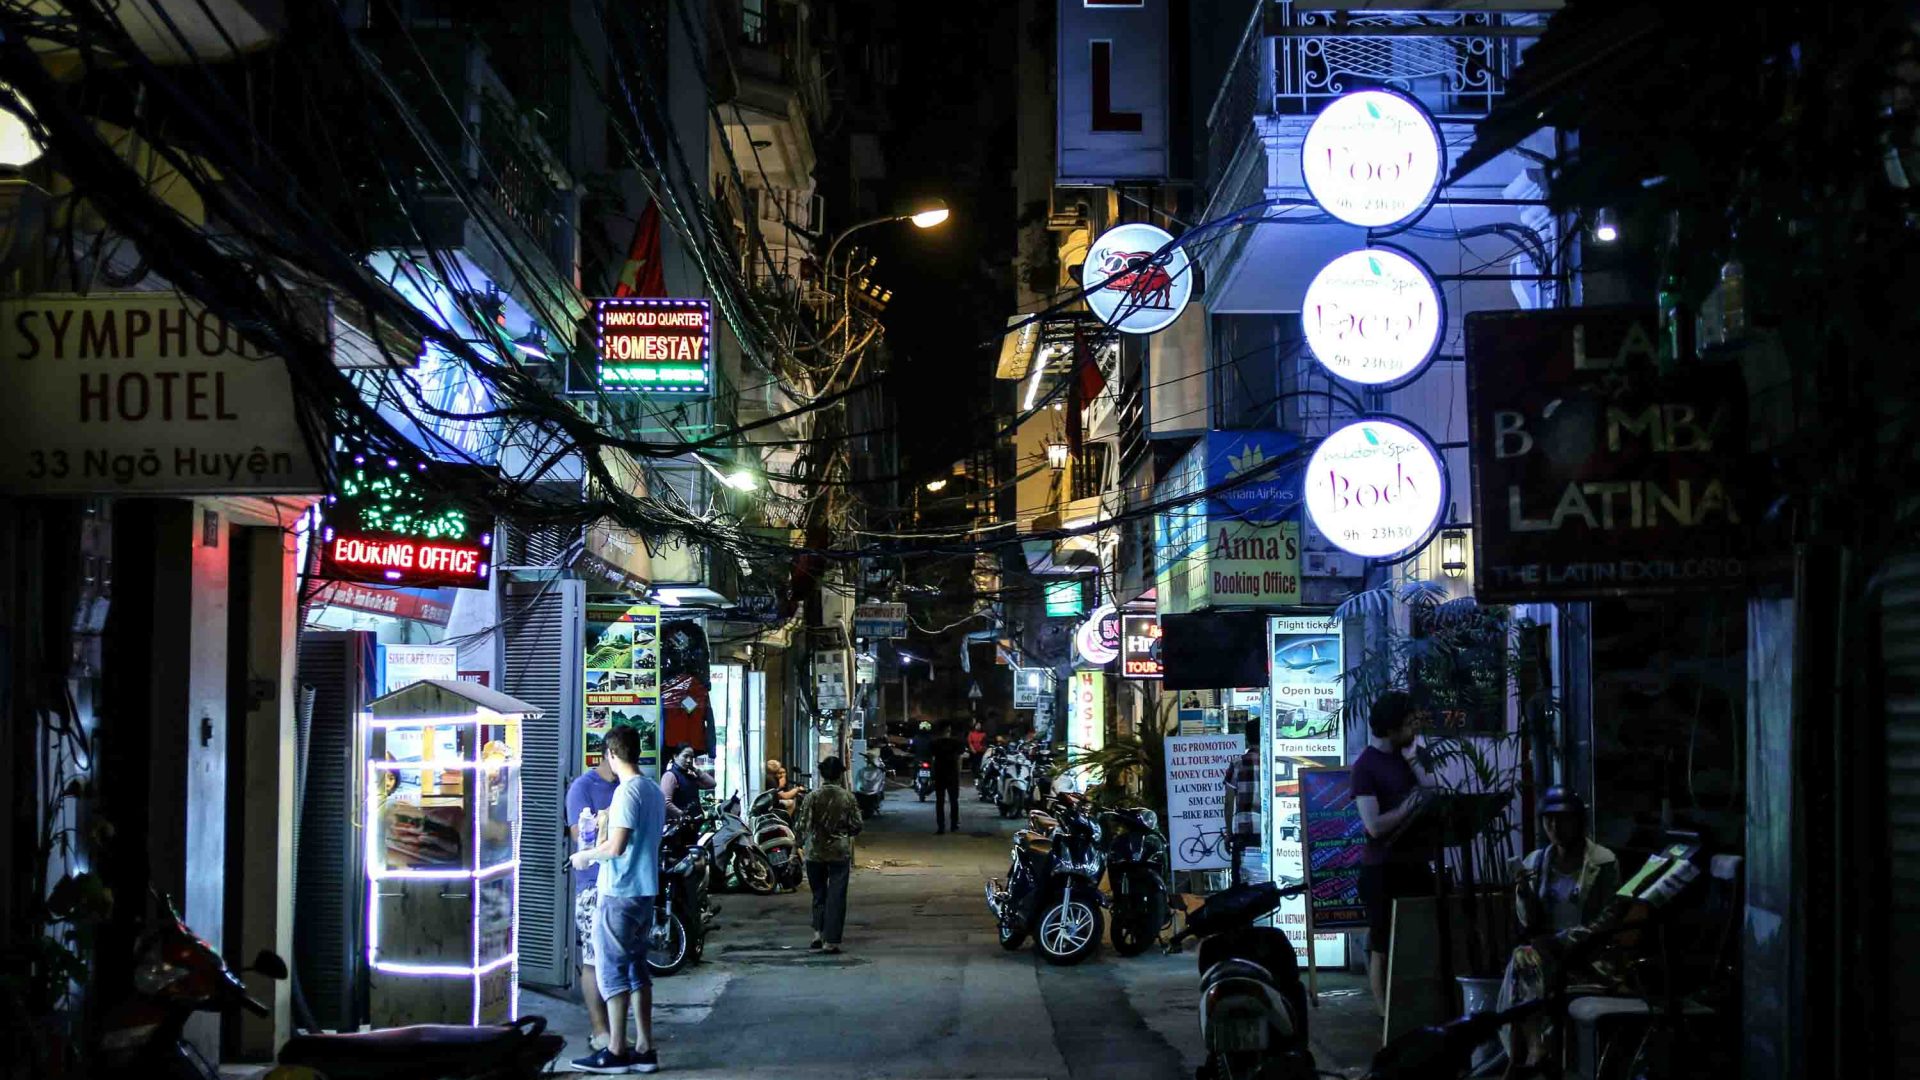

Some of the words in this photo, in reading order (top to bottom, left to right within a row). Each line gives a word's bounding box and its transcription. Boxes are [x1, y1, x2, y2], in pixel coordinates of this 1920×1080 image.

[606, 312, 635, 326] HANOI
[637, 312, 657, 326] OLD
[658, 312, 703, 327] QUARTER
[16, 308, 264, 360] SYMPHO
[605, 335, 704, 360] HOMESTAY
[79, 371, 237, 423] HOTEL
[26, 449, 70, 479] 33
[175, 446, 293, 481] Huyện
[1256, 486, 1295, 500] Airlines
[1507, 477, 1742, 533] LATINA
[1343, 529, 1360, 541] 9h
[1371, 527, 1412, 540] 23h30
[1214, 526, 1297, 561] Anna's
[418, 546, 479, 573] OFFICE
[1213, 571, 1260, 597] Booking
[1263, 570, 1297, 595] Office
[1278, 620, 1304, 631] Flight
[1306, 620, 1337, 630] tickets
[1281, 686, 1311, 698] Open
[1314, 686, 1334, 696] bus
[1173, 743, 1188, 753] BIG
[1189, 740, 1237, 752] PROMOTION
[1280, 743, 1304, 753] Train
[1305, 743, 1336, 753] tickets
[1171, 756, 1188, 767] ALL
[1188, 755, 1210, 766] TOUR
[1169, 769, 1201, 781] MONEY
[1174, 783, 1213, 794] LAUNDRY
[1189, 797, 1204, 807] SIM
[1183, 810, 1202, 820] BIKE
